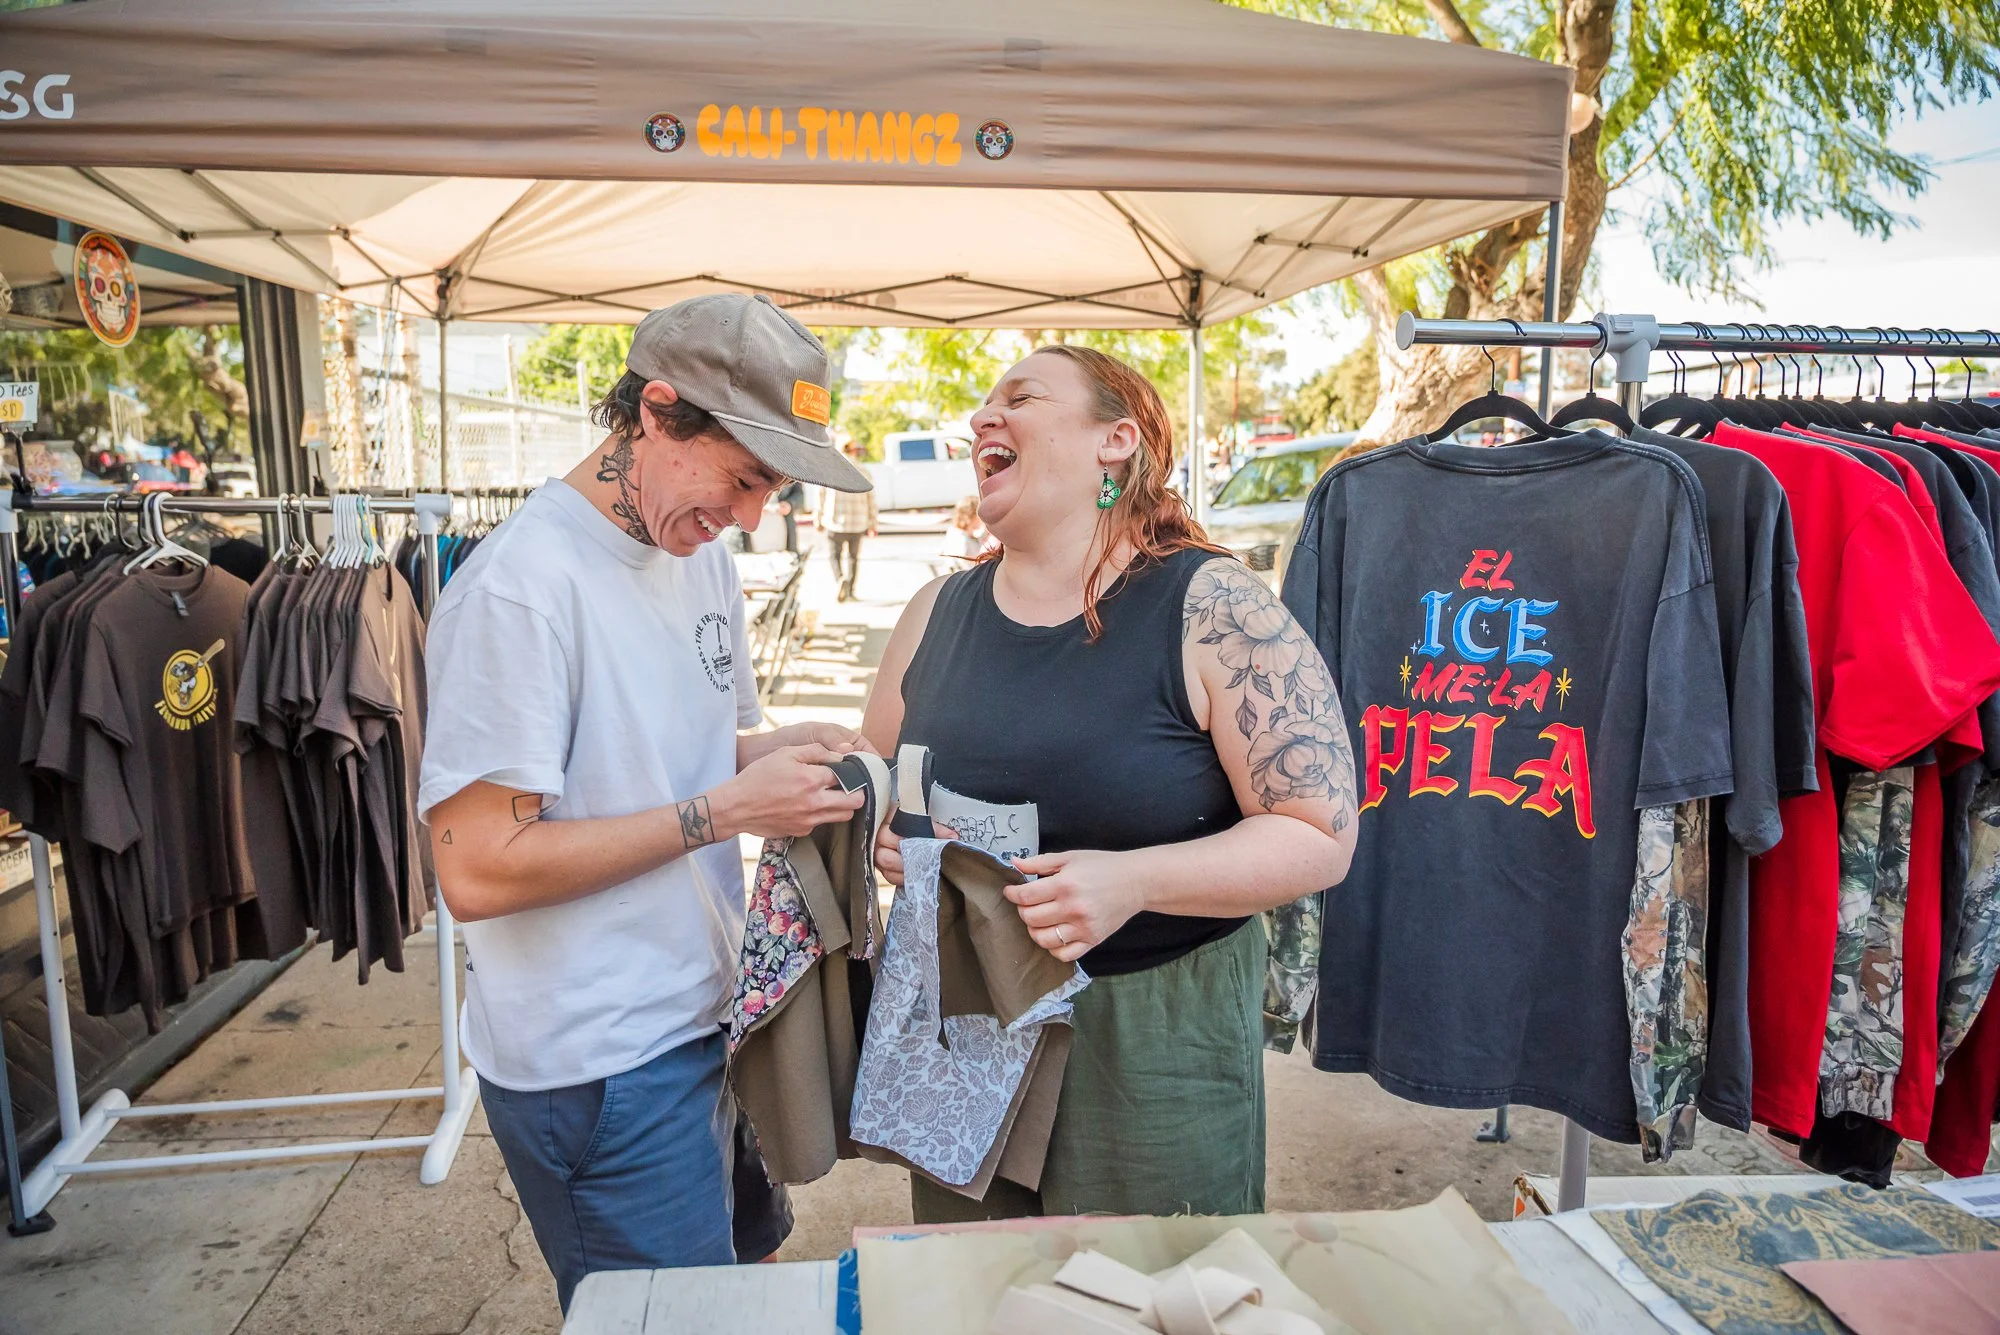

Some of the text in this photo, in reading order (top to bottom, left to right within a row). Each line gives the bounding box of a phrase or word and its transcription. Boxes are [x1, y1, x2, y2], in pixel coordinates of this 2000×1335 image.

[0, 70, 74, 120] SG
[697, 104, 961, 166] CALI-THANGZ
[1459, 549, 1515, 591] EL
[695, 612, 729, 644] THE FRIEND
[1418, 590, 1559, 666] ICE
[1358, 704, 1597, 839] PELA
